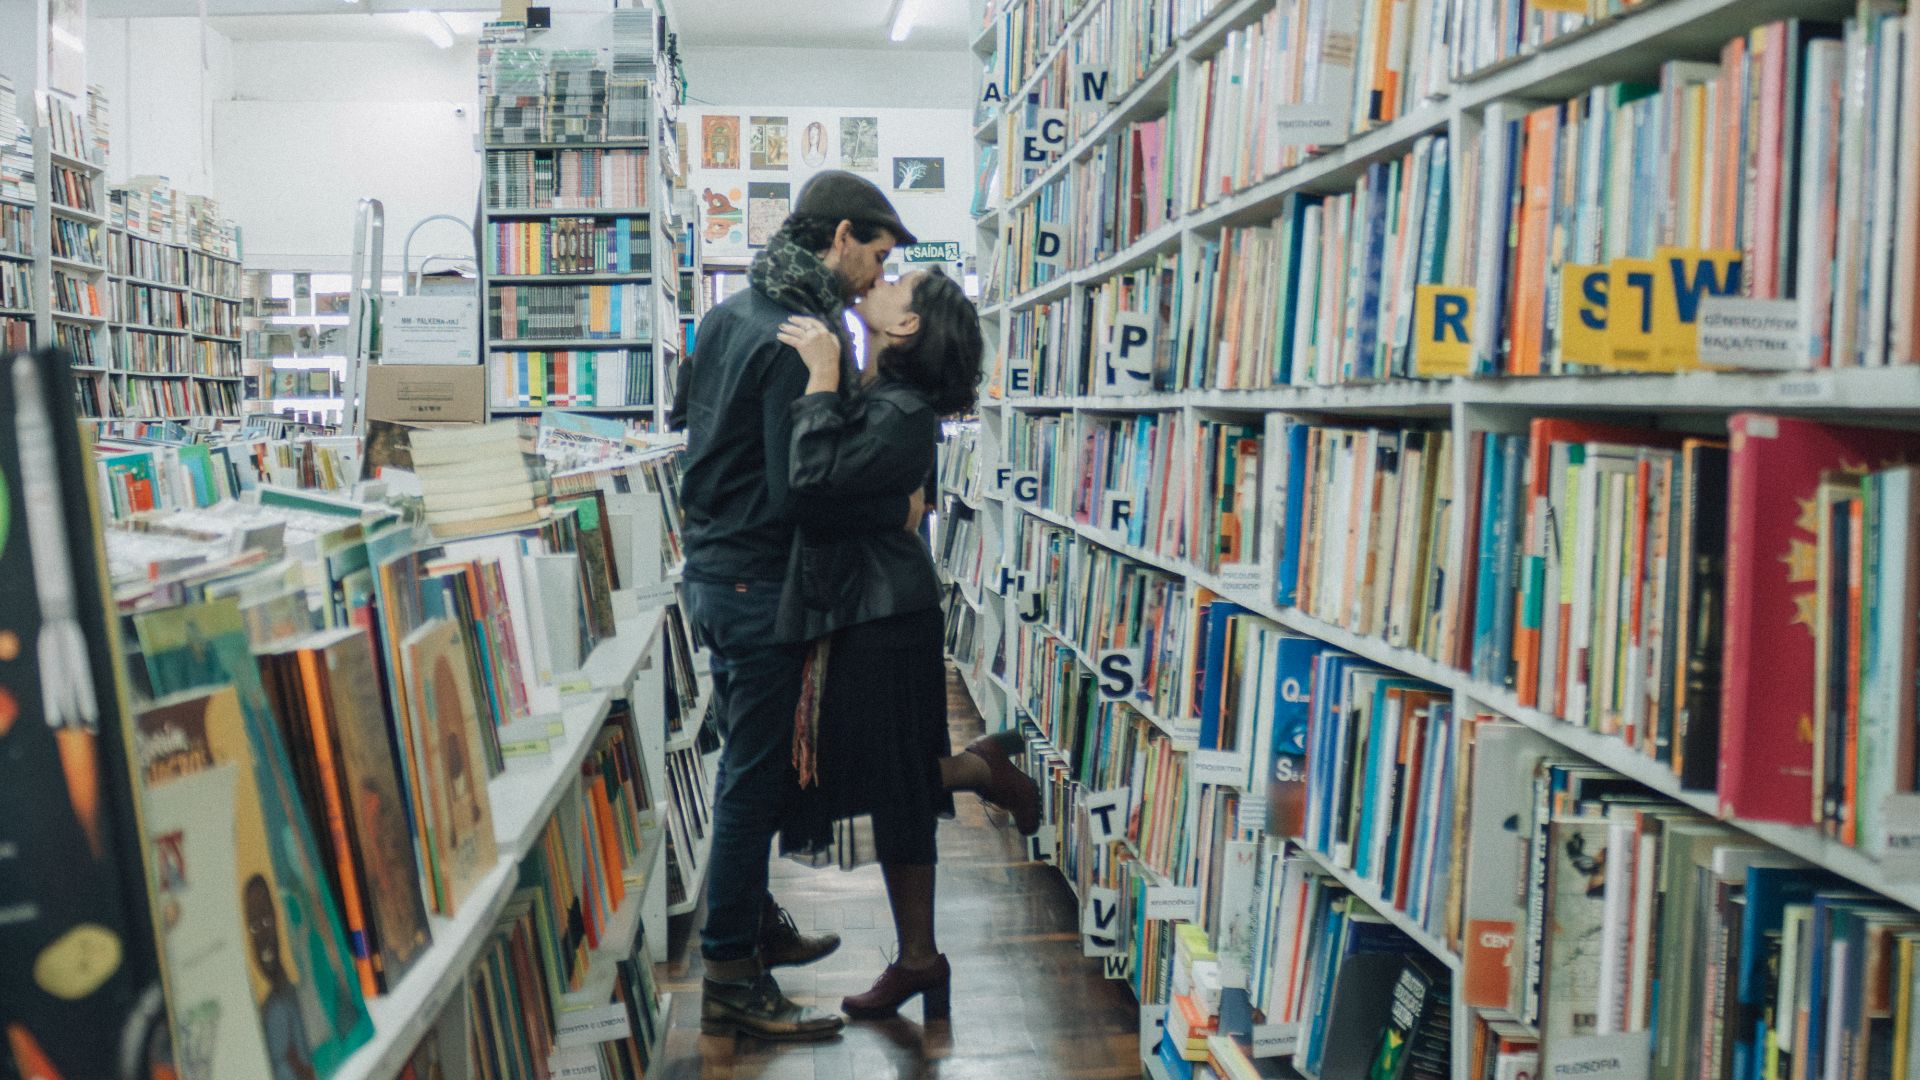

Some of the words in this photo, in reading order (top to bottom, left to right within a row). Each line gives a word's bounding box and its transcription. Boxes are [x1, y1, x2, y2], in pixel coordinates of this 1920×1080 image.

[983, 82, 1001, 102] A
[1042, 118, 1065, 144] C
[1023, 136, 1047, 161] B
[913, 244, 945, 258] SAÍDA
[1038, 231, 1060, 257] D
[1580, 272, 1611, 330] S
[1670, 258, 1741, 324] W
[1433, 294, 1470, 343] R
[1119, 324, 1148, 358] P
[1011, 368, 1029, 391] E
[997, 468, 1011, 489] F
[1014, 476, 1038, 502] G
[1111, 500, 1130, 530] R
[1020, 593, 1042, 622] J
[1100, 654, 1134, 699] S
[1091, 803, 1117, 836] T
[1032, 837, 1051, 860] L
[1093, 898, 1116, 931] V
[1107, 956, 1129, 977] W
[1555, 1058, 1619, 1075] FILOSOFIA
